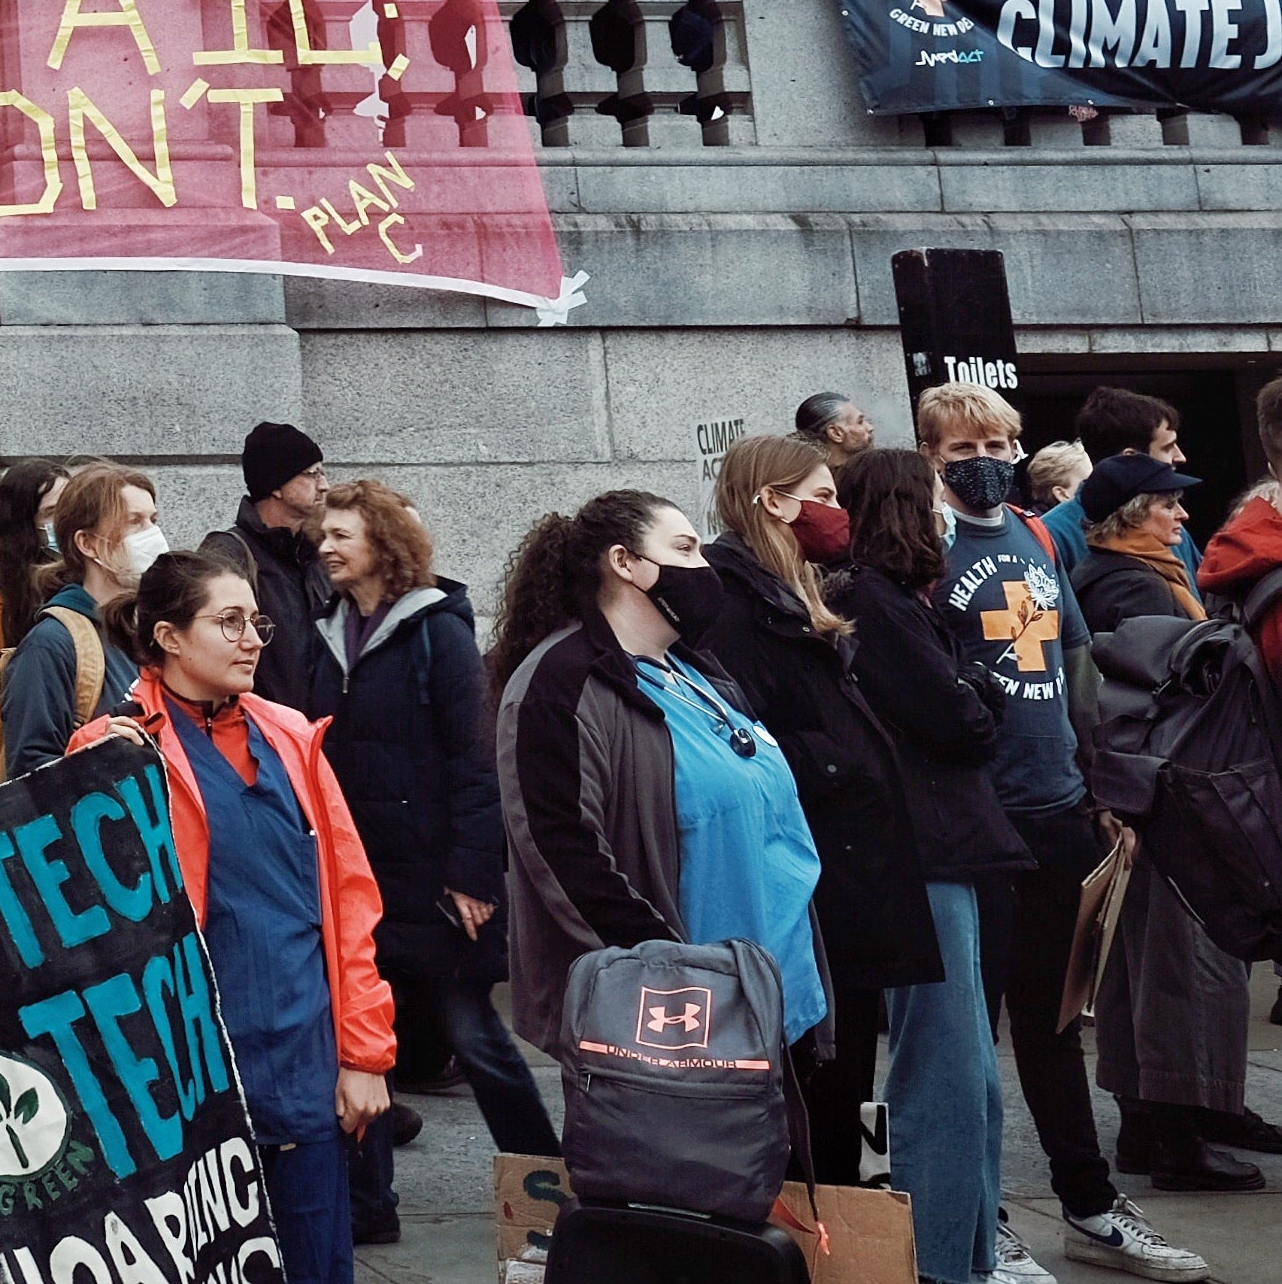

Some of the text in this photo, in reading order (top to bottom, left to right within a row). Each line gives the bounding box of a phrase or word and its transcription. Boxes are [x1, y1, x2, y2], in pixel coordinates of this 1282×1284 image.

[889, 8, 930, 34] GREEN
[932, 22, 958, 37] NEW
[300, 151, 416, 255] PLAN
[378, 212, 423, 264] C
[944, 356, 1018, 389] Toilets
[948, 555, 998, 612] HEALTH
[1022, 680, 1054, 700] NEW
[17, 932, 230, 1180] TECH
[607, 1045, 737, 1069] UNDER ARMOUR
